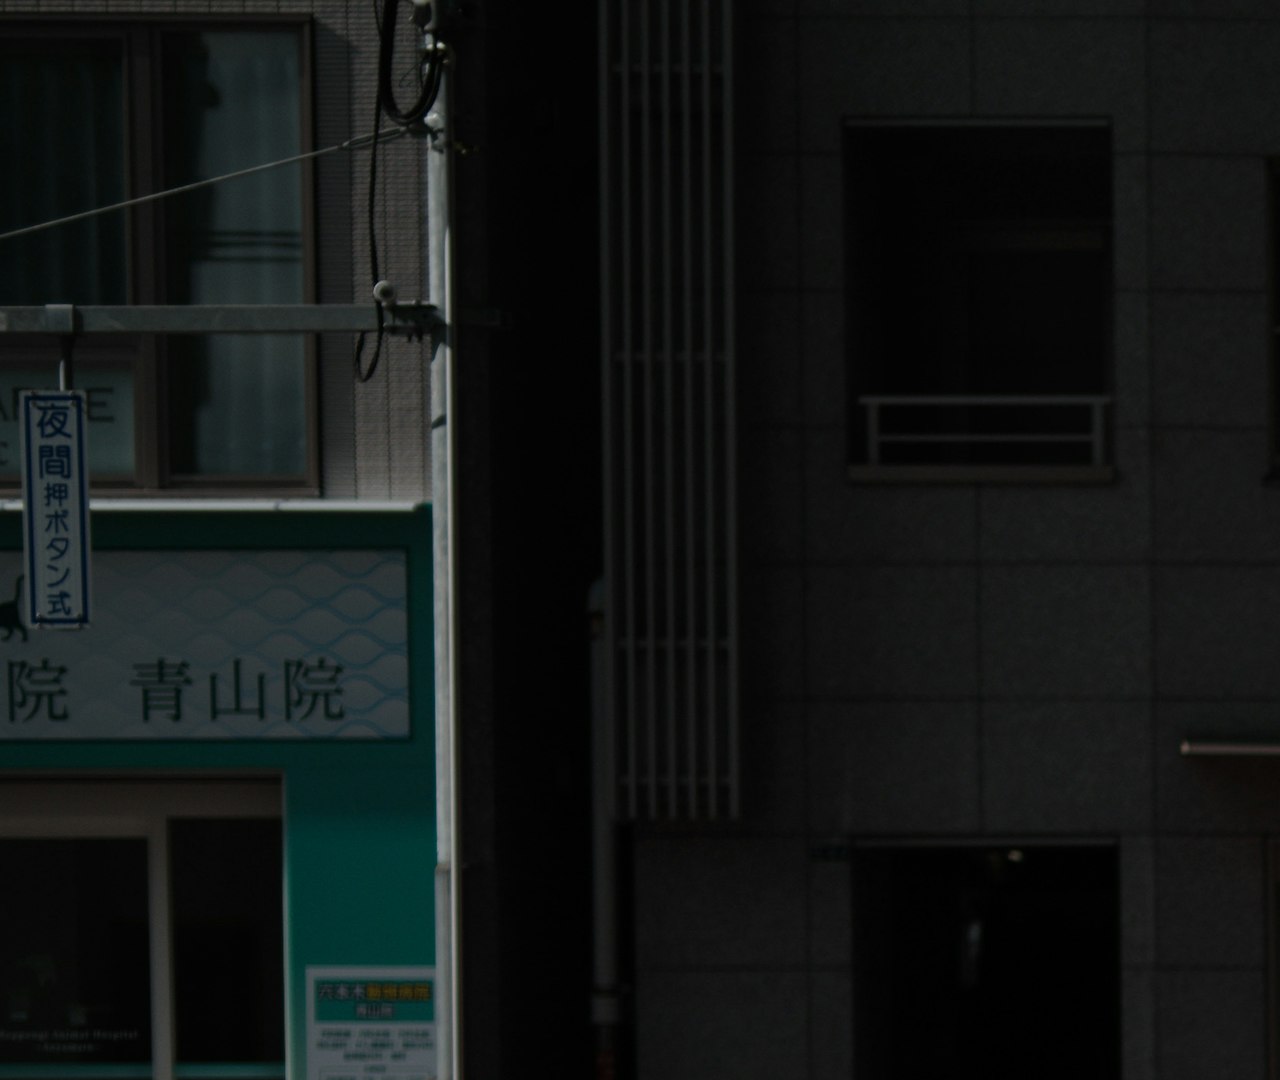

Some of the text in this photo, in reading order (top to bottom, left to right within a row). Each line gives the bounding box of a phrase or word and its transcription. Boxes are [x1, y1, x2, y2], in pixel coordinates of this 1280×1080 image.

[36, 403, 72, 617] 夜間押ボタン式
[129, 657, 345, 722] 青山院
